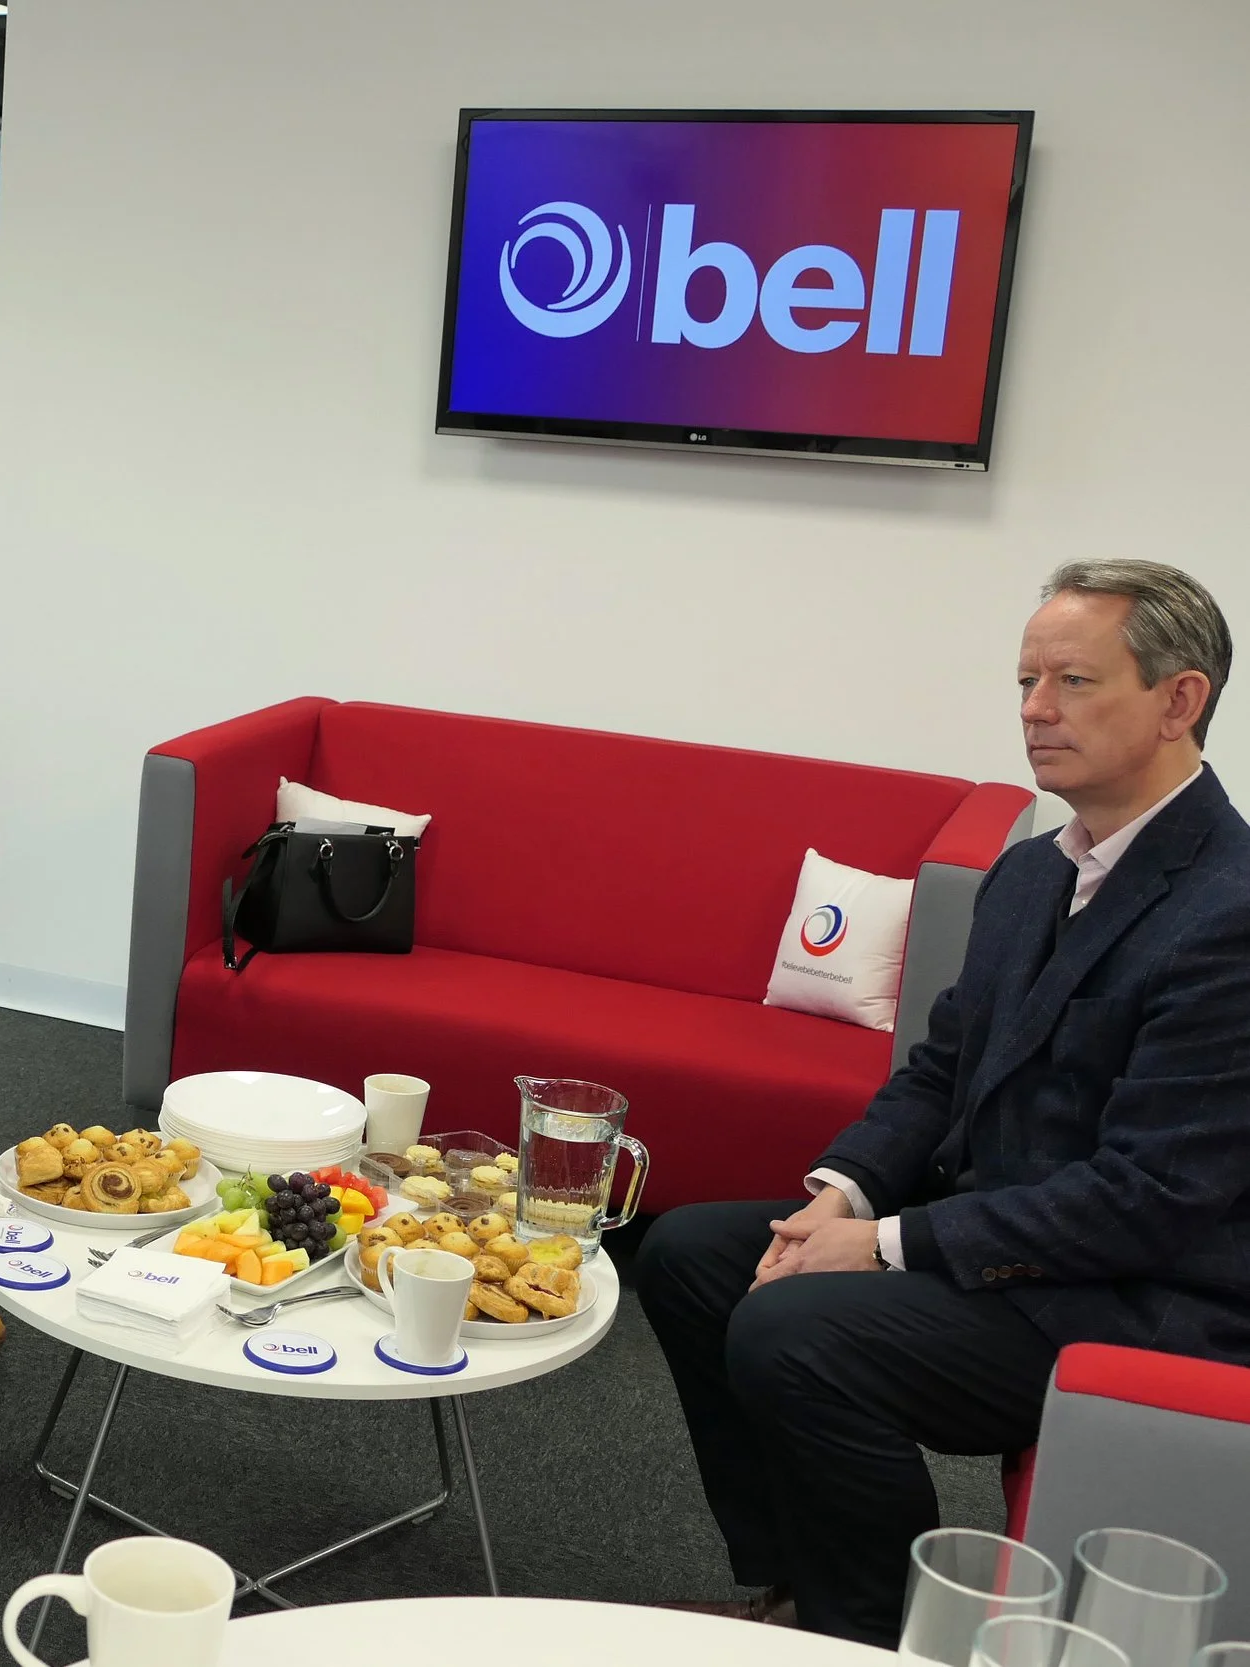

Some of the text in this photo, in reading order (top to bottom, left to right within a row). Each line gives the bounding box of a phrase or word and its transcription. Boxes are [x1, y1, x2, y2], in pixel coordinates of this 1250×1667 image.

[651, 203, 960, 356] bell
[20, 1264, 53, 1278] bell
[144, 1272, 180, 1284] bell
[282, 1344, 318, 1355] bell
